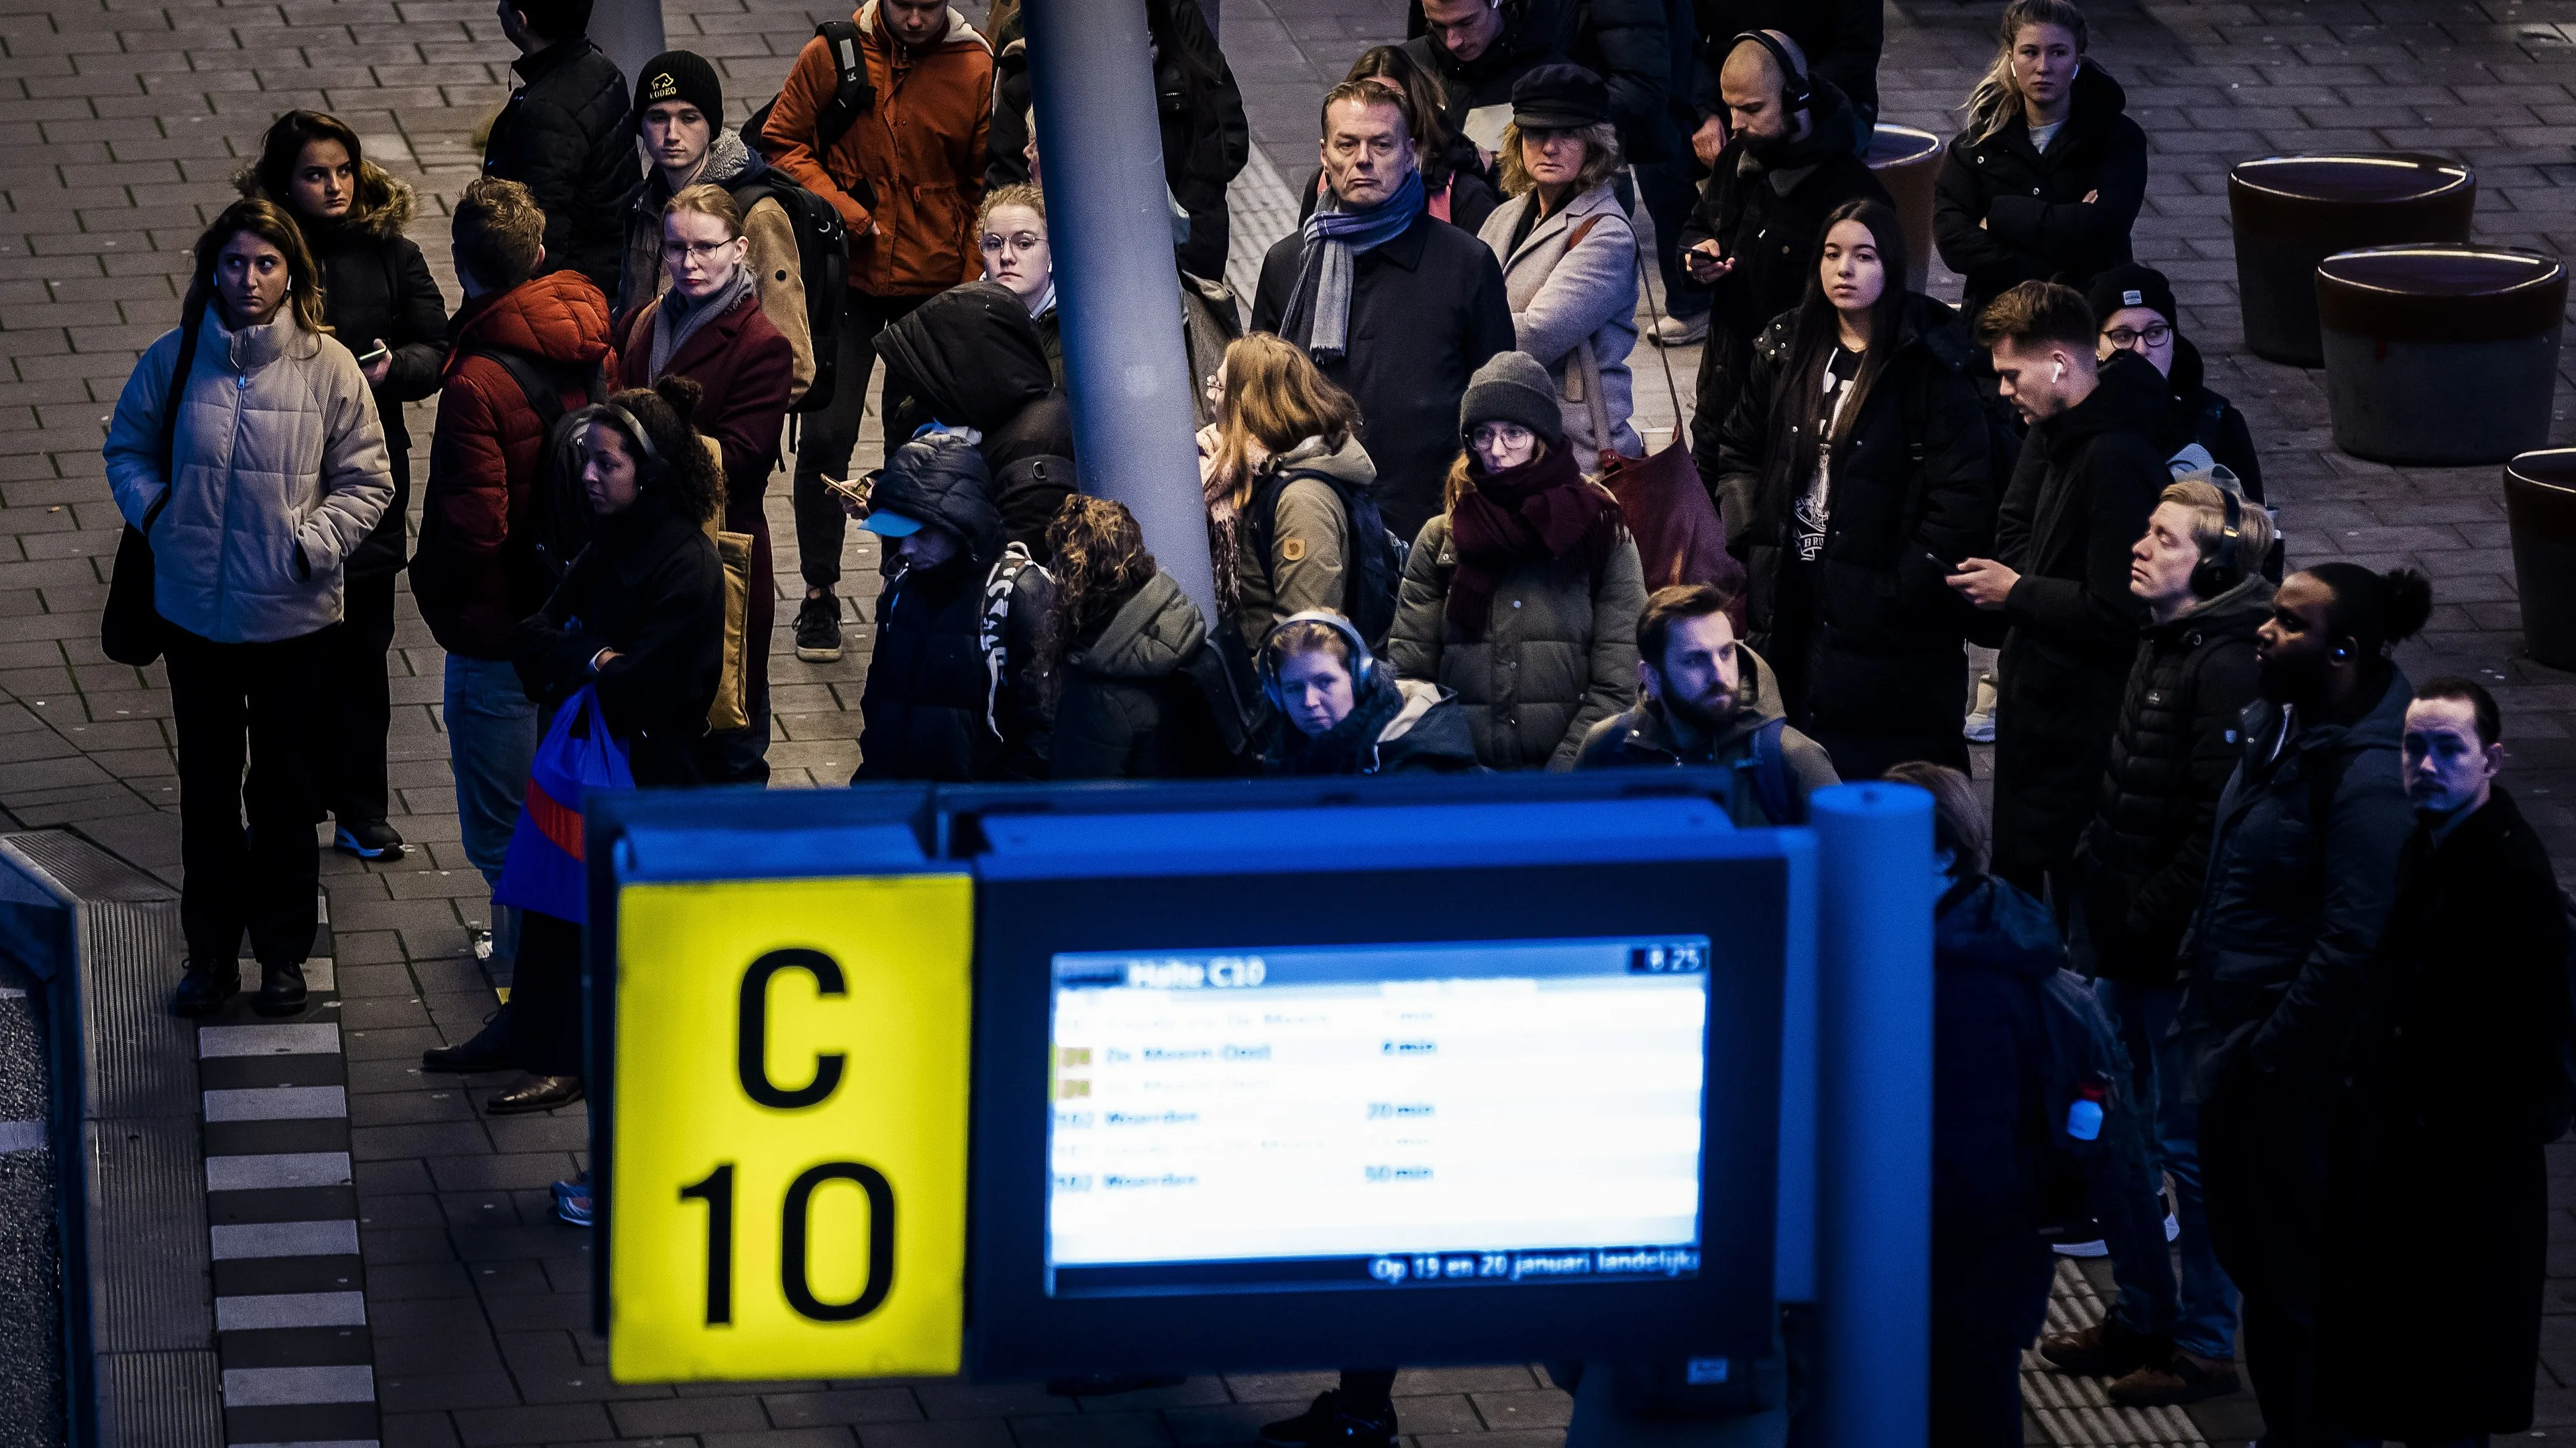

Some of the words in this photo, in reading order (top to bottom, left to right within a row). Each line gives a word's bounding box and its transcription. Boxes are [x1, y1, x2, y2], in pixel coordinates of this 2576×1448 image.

[1208, 956, 1267, 988] C10
[738, 946, 847, 1109] C
[1396, 1101, 1436, 1118] min
[1394, 1164, 1434, 1182] min
[678, 1162, 895, 1325] 10
[1375, 1257, 1407, 1284] Op
[1413, 1256, 1440, 1278] 19
[1445, 1258, 1474, 1278] en
[1479, 1254, 1508, 1276] 20
[1509, 1251, 1591, 1281] januari
